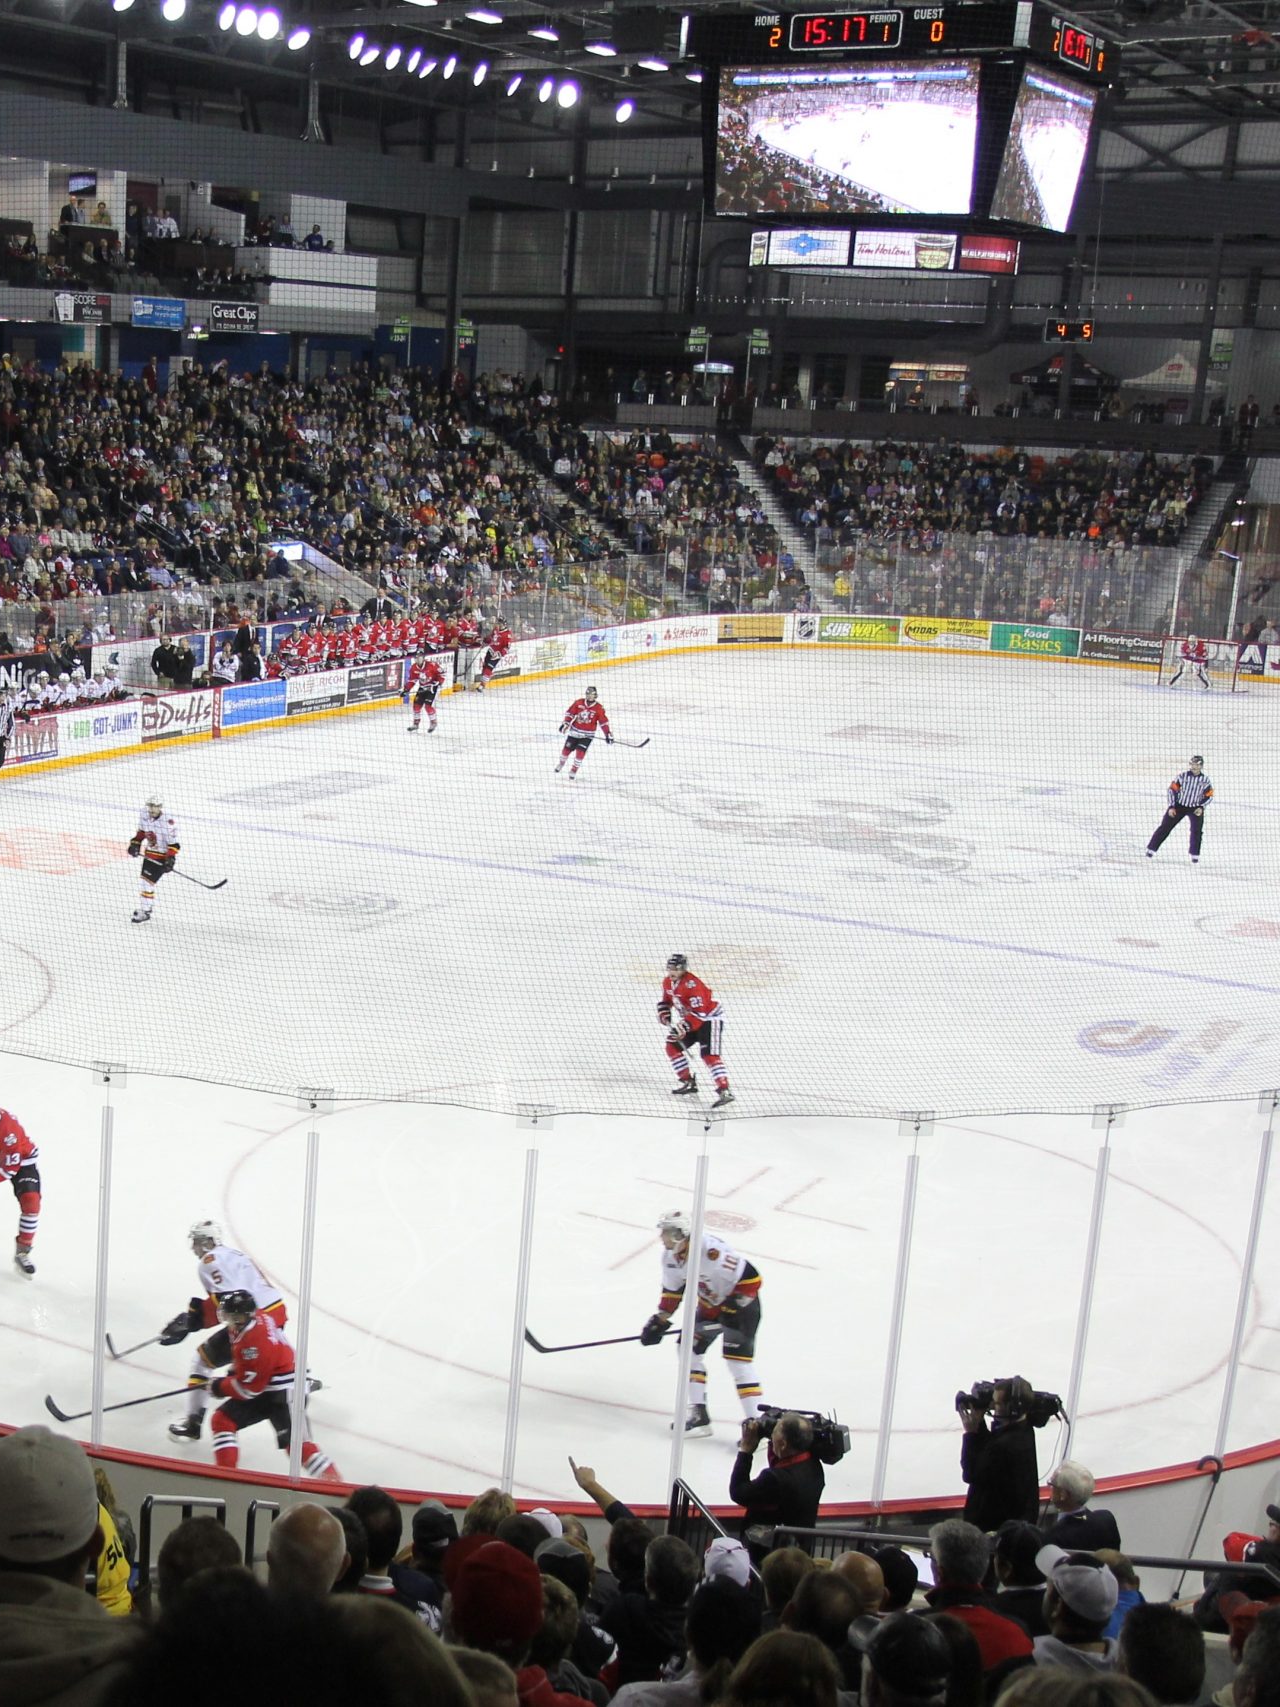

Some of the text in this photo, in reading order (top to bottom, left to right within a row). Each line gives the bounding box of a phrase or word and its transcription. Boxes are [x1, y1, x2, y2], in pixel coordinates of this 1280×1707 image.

[755, 8, 944, 26] HOME PERIOD GUEST
[769, 17, 943, 47] 2 15:17 1 0
[856, 243, 910, 256] Tim Hortons
[213, 305, 256, 322] Great Clips
[1057, 324, 1091, 338] 4 5
[821, 622, 886, 638] SUBWAY
[908, 626, 938, 635] MIDAS
[1024, 628, 1050, 639] food
[1009, 633, 1062, 653] Basics
[1084, 633, 1098, 642] A-1
[1098, 634, 1133, 647] Flooring
[320, 675, 345, 686] RICOH
[159, 695, 211, 729] Duffs
[5, 1153, 21, 1166] 13
[211, 1270, 223, 1284] 5
[243, 1371, 257, 1383] 7
